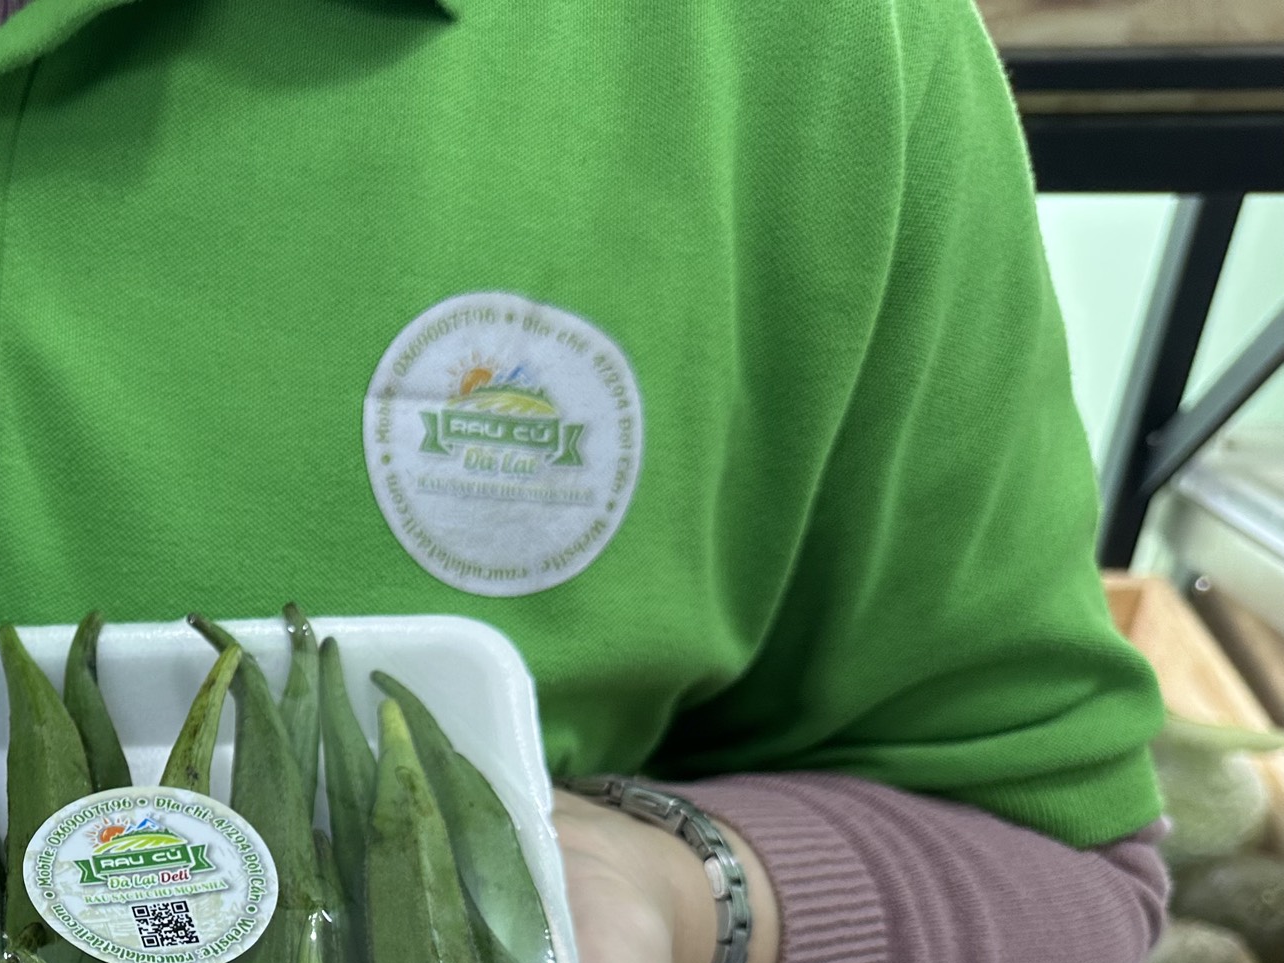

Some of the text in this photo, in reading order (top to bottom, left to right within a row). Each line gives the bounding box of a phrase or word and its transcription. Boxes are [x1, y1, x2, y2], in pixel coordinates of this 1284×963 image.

[449, 419, 503, 438] RAU
[38, 798, 132, 887] Mobile: 0869007796
[215, 818, 252, 853] 4/294
[100, 854, 144, 869] RAU
[109, 869, 189, 889] Đà Lạt Deli
[84, 894, 109, 904] RAU
[52, 904, 254, 963] Website: raucudalatdeli.com
